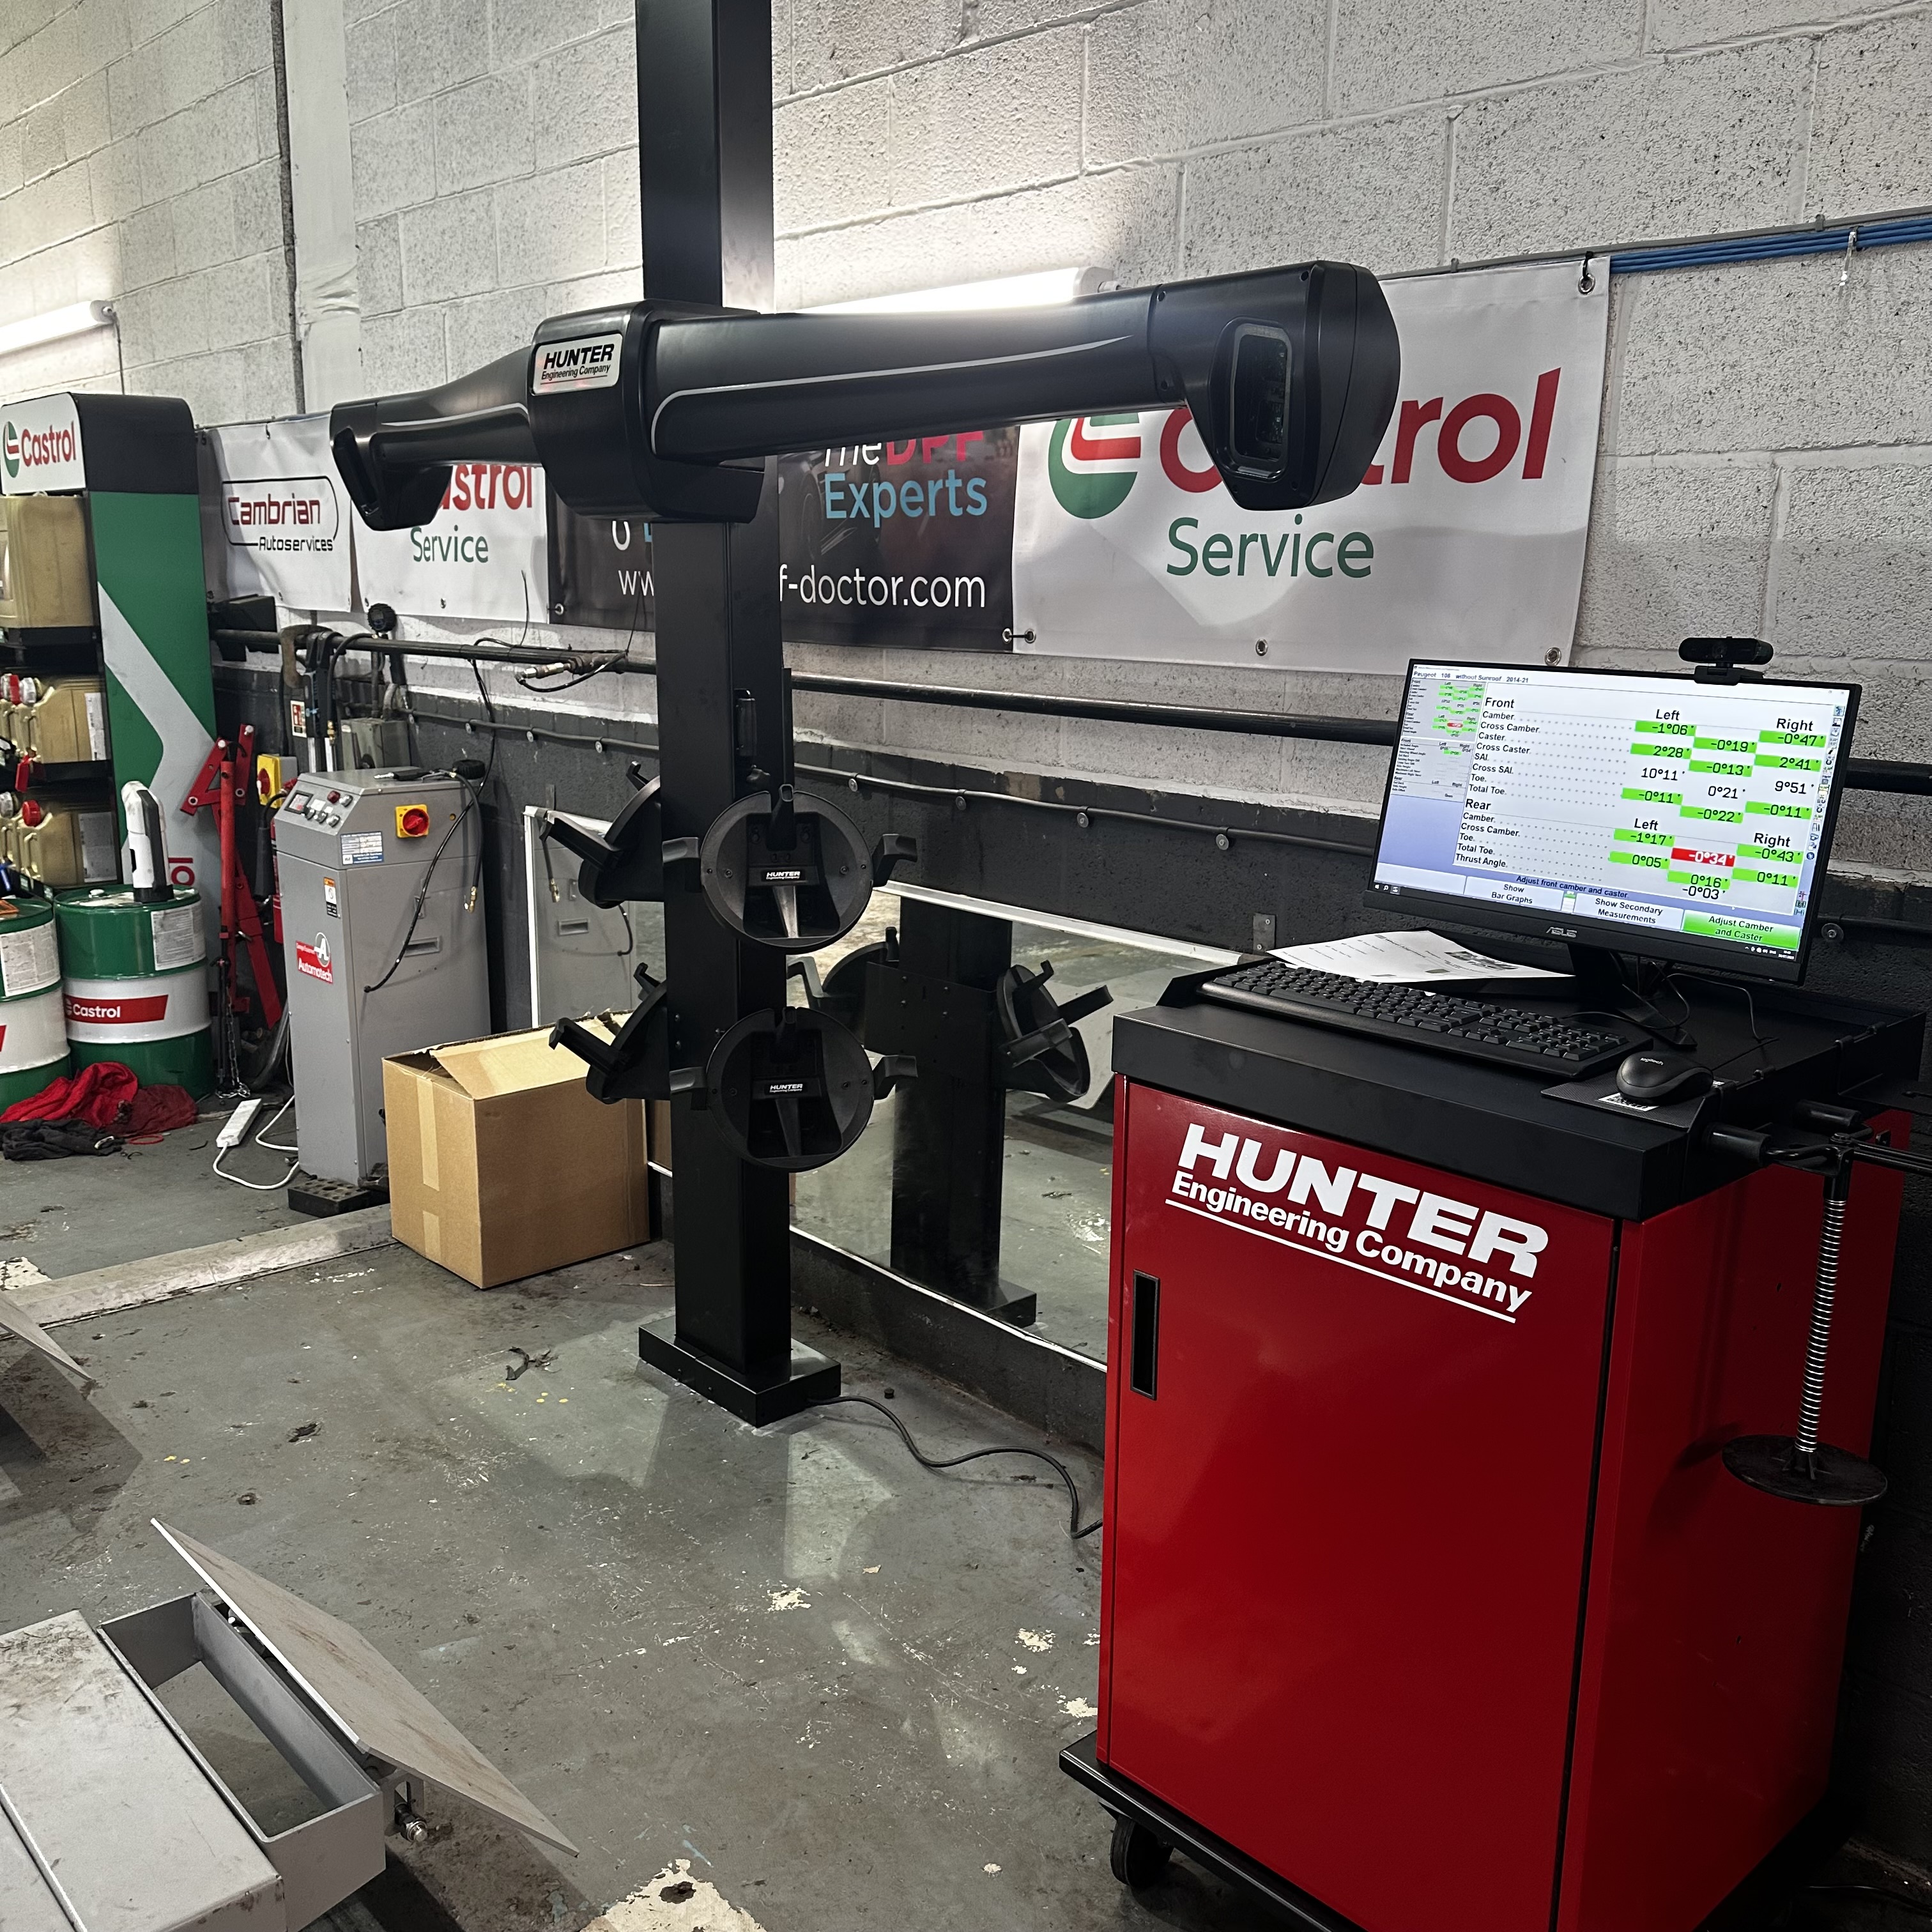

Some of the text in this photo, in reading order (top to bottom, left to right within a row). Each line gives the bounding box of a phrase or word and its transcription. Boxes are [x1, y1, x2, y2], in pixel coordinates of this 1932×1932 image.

[544, 344, 615, 369] HUNTER
[541, 364, 611, 381] Engineering Company
[21, 420, 77, 467] Castrol
[824, 470, 988, 528] Experts
[228, 493, 321, 526] Cambrian
[259, 535, 333, 552] Autoservices
[410, 525, 489, 563] Service
[1167, 514, 1375, 579] Service
[1485, 698, 1515, 709] Front
[1482, 711, 1514, 721] Camber
[1656, 709, 1680, 721] Left
[1480, 721, 1505, 731] Cross
[1506, 723, 1540, 733] Camber
[1777, 718, 1814, 733] Right
[1478, 732, 1506, 741] Caster
[1476, 742, 1501, 751] Cross
[1503, 744, 1531, 754] Caster
[1473, 763, 1496, 772] Cross
[1471, 773, 1485, 782] Toe
[1469, 784, 1505, 795] Total Toe
[1465, 799, 1492, 810] Rear
[1463, 812, 1494, 823] Camber
[1634, 818, 1659, 831] Left
[1459, 832, 1474, 841] Toe
[1460, 823, 1519, 837] Cross Camber
[1753, 832, 1791, 848] Right
[1457, 843, 1493, 855] Total Toe
[1456, 853, 1506, 868] Thrust Angle
[1503, 884, 1525, 893] Show
[1515, 875, 1629, 899] Adjust front camber and caster
[1491, 891, 1533, 905] Bar Graphs
[1595, 898, 1664, 916] Show Secondary
[1598, 908, 1657, 924] Measurements
[1708, 916, 1774, 933] Adjust Camber
[1546, 926, 1577, 939] ASUS
[1715, 928, 1763, 942] and Caster
[72, 1004, 121, 1018] Castrol
[1177, 1123, 1549, 1278] HUNTER
[1171, 1170, 1533, 1312] Engineering Company
